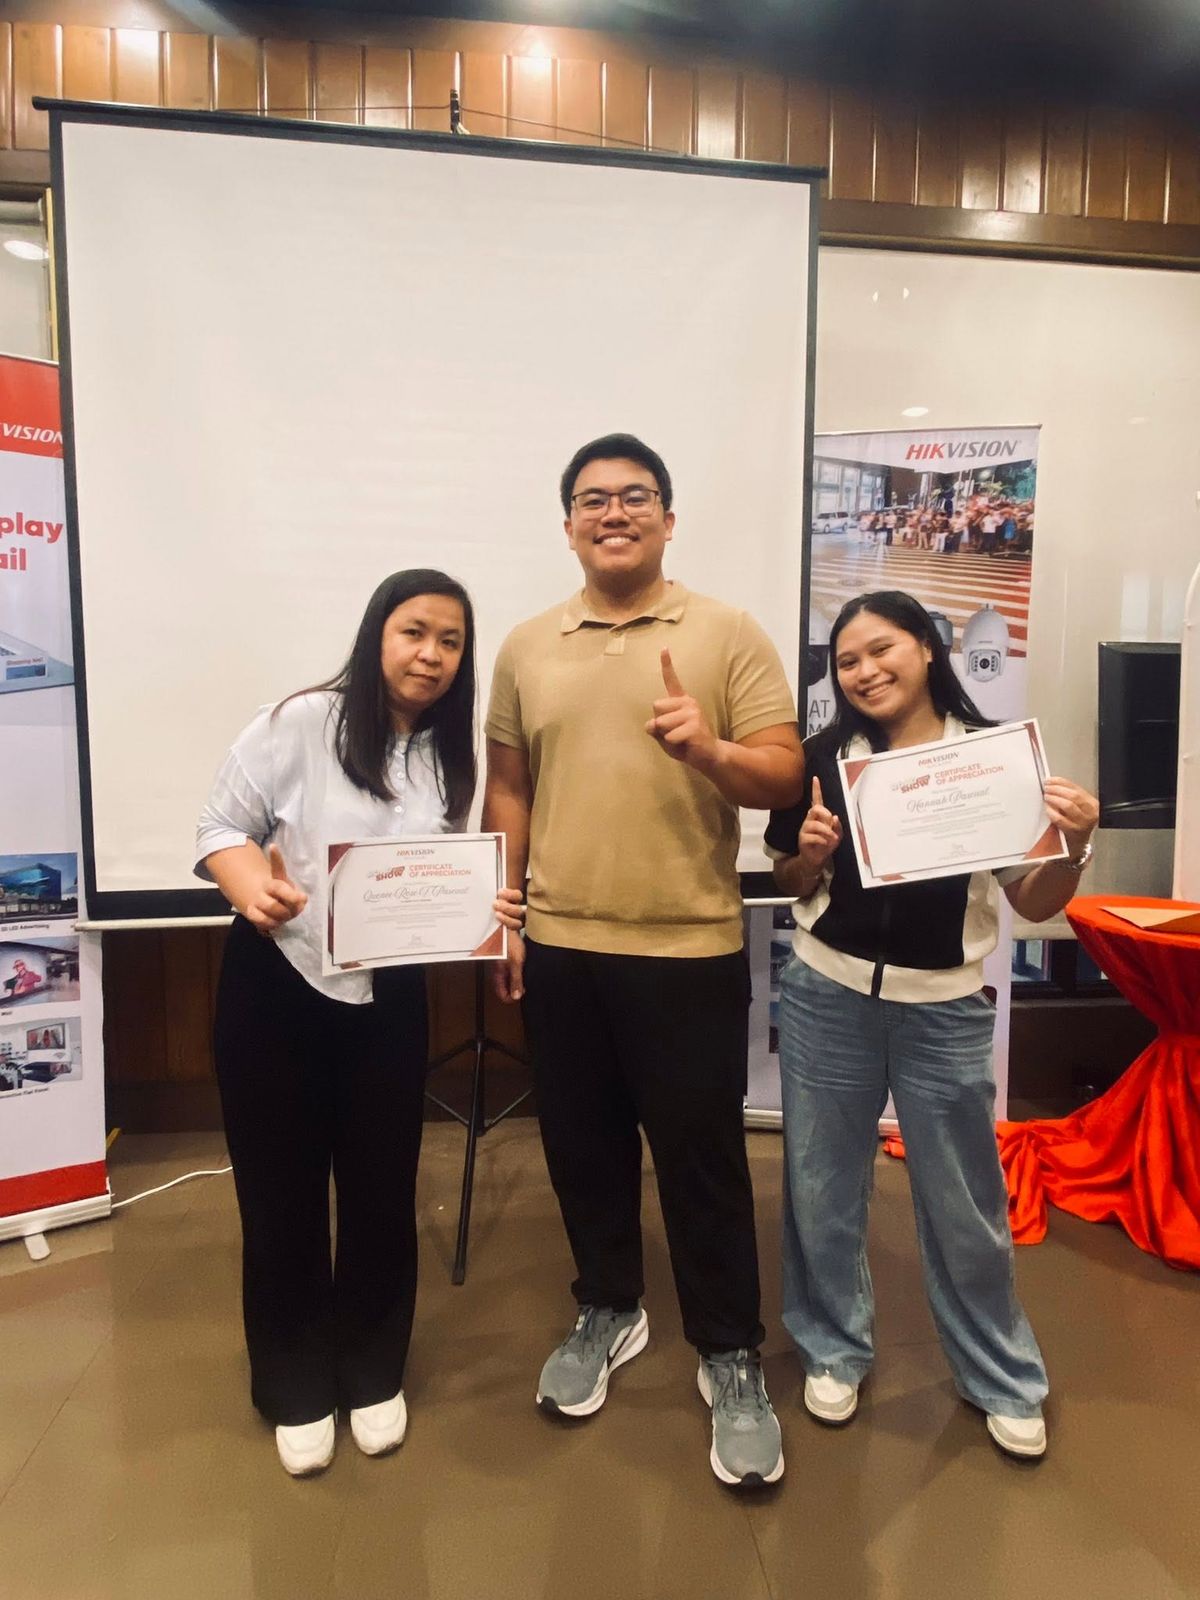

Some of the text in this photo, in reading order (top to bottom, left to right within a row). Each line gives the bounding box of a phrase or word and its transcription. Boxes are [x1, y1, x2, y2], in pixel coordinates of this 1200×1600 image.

[0, 423, 63, 445] VISION
[905, 440, 1018, 460] HIKVISION
[809, 699, 830, 718] AT
[934, 763, 981, 779] CERTIFICATE
[948, 765, 1004, 783] APPRECIATION
[901, 777, 930, 794] SHOW
[376, 868, 404, 881] SHOW
[409, 869, 471, 878] OF APPRECIATION
